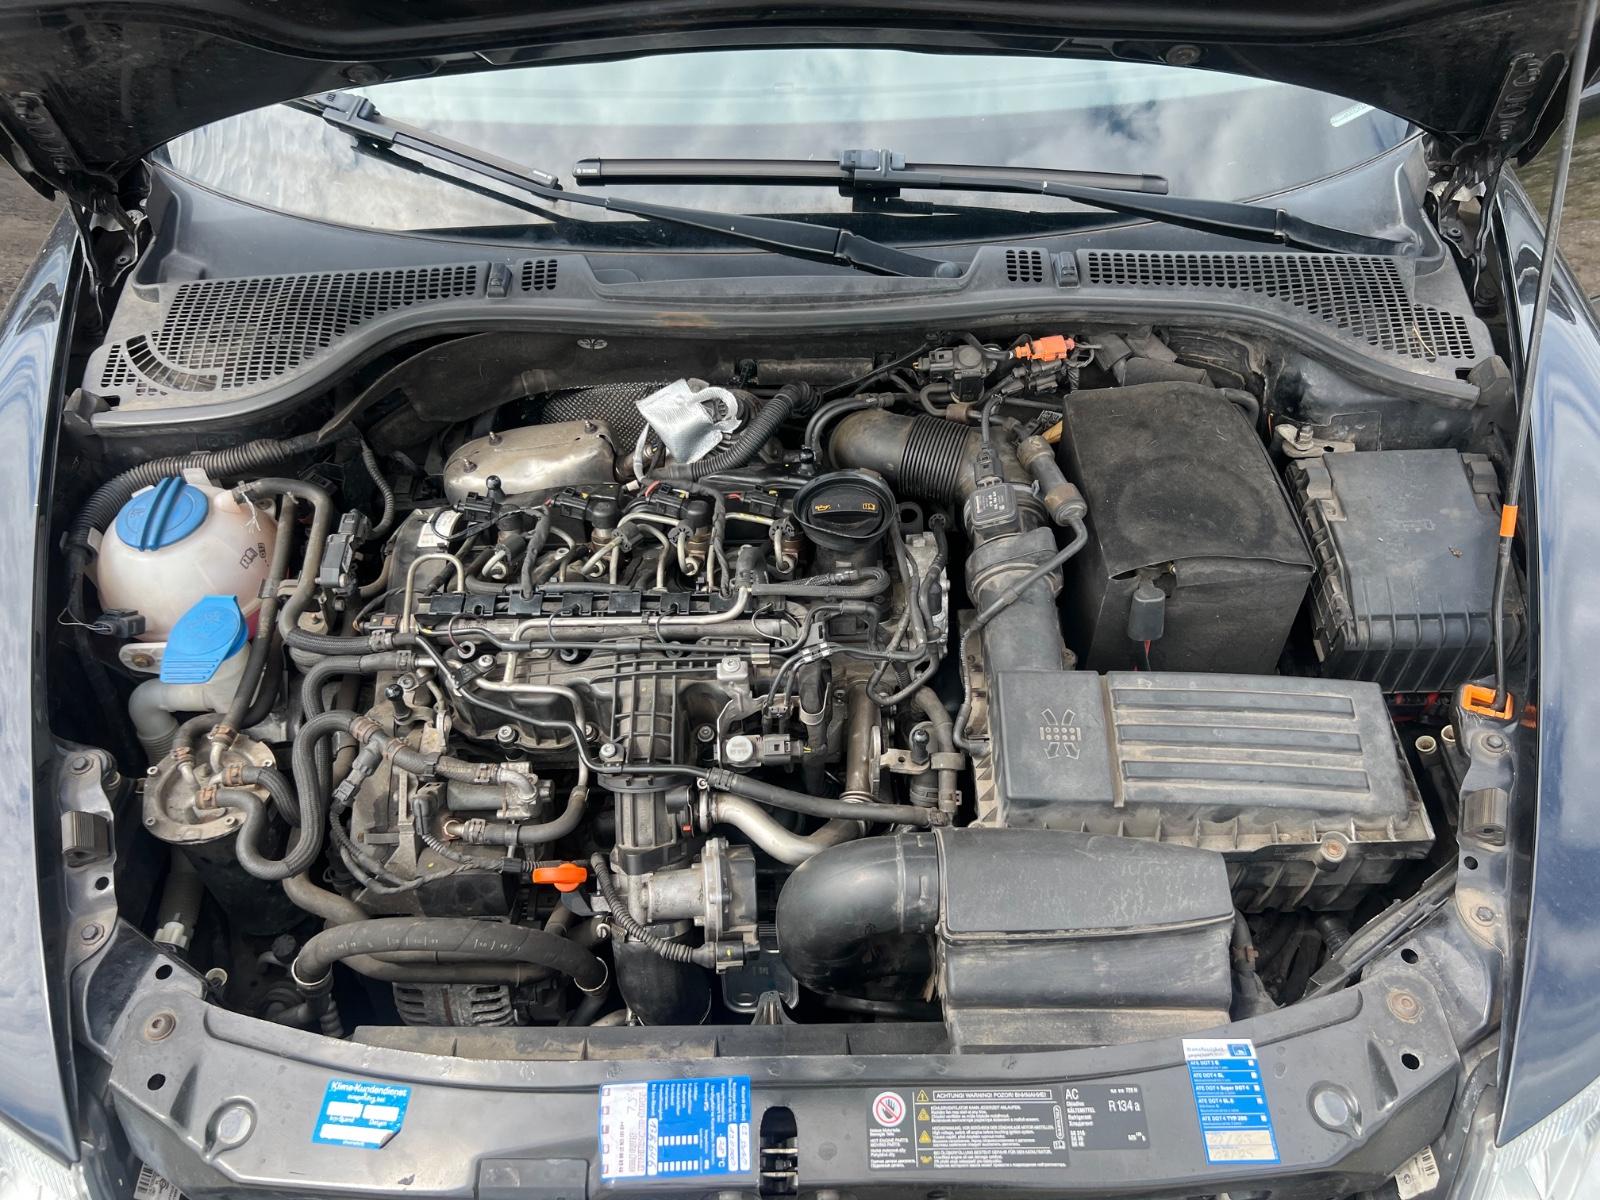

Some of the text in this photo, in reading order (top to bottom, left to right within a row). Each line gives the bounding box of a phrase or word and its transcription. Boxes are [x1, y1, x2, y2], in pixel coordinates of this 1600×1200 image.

[1065, 1088, 1079, 1100] AC
[1108, 1100, 1141, 1112] R 134 a
